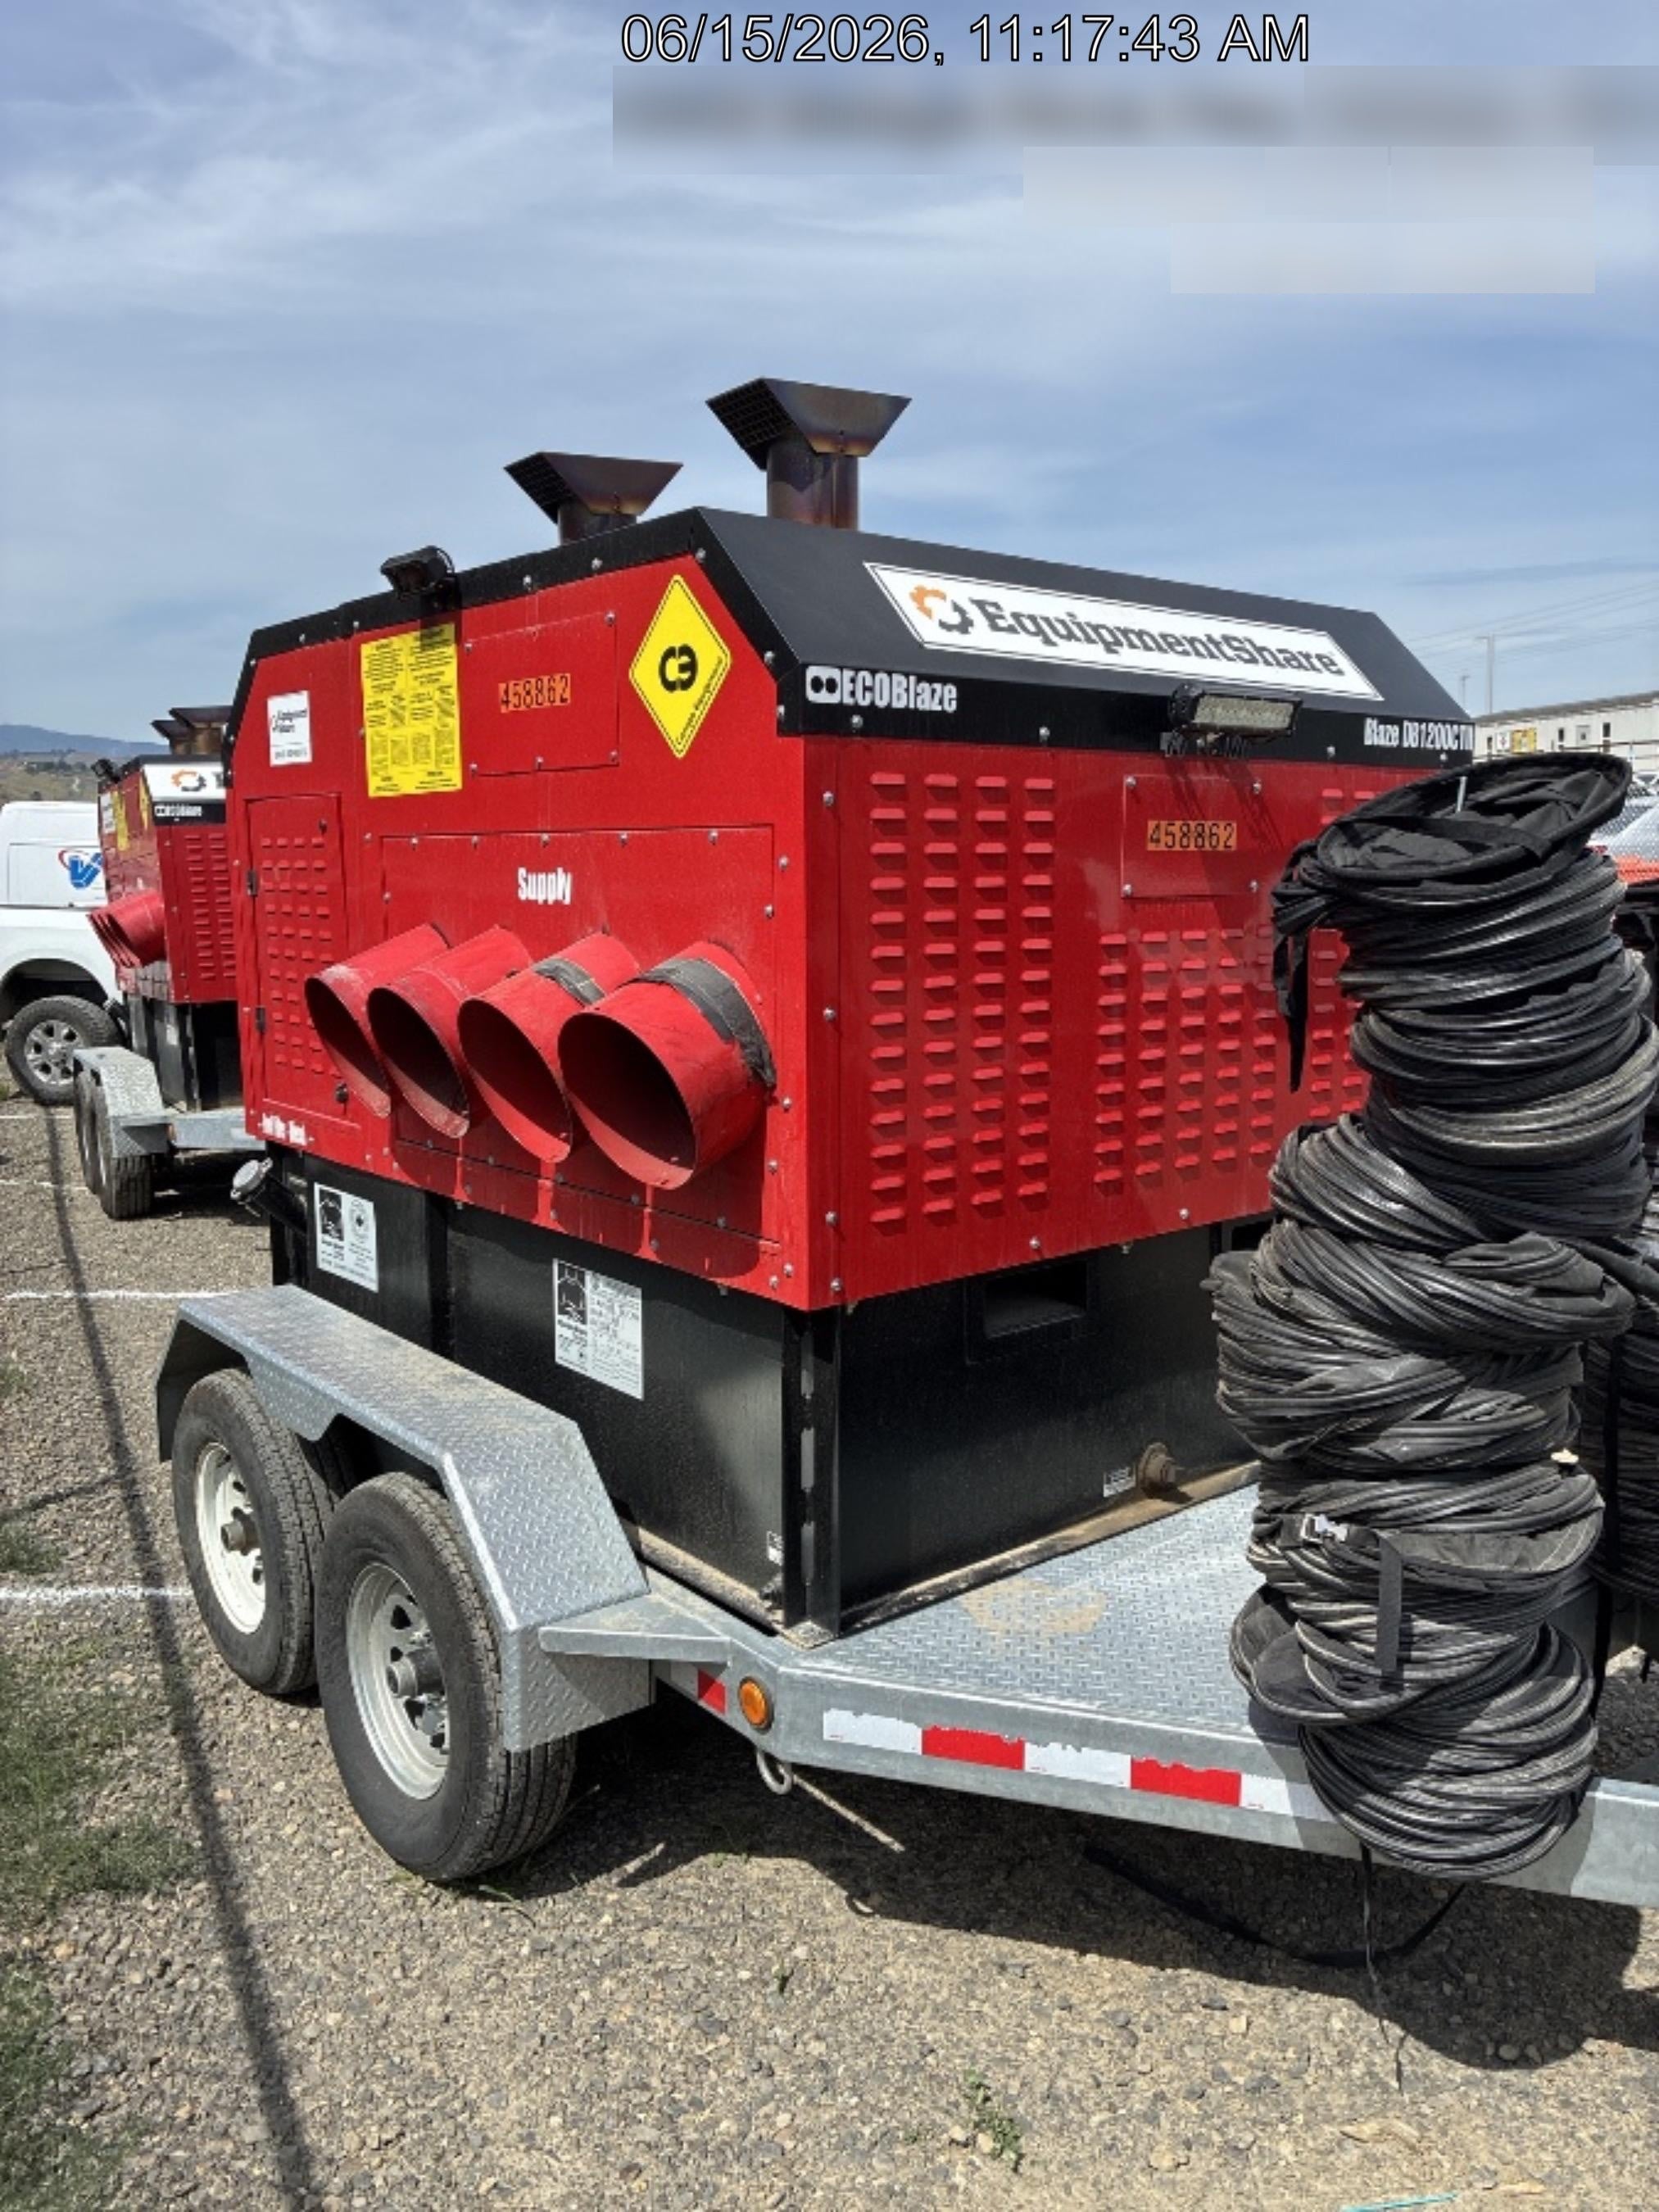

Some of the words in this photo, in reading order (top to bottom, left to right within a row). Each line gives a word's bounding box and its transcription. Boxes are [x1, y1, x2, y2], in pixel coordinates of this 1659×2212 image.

[969, 596, 1345, 678] EquipmentShare
[500, 673, 569, 709] 458862
[841, 668, 958, 714] ECOBlaze
[1363, 717, 1400, 747] Blaze
[1149, 820, 1235, 850] 458862
[517, 866, 573, 906] Supply
